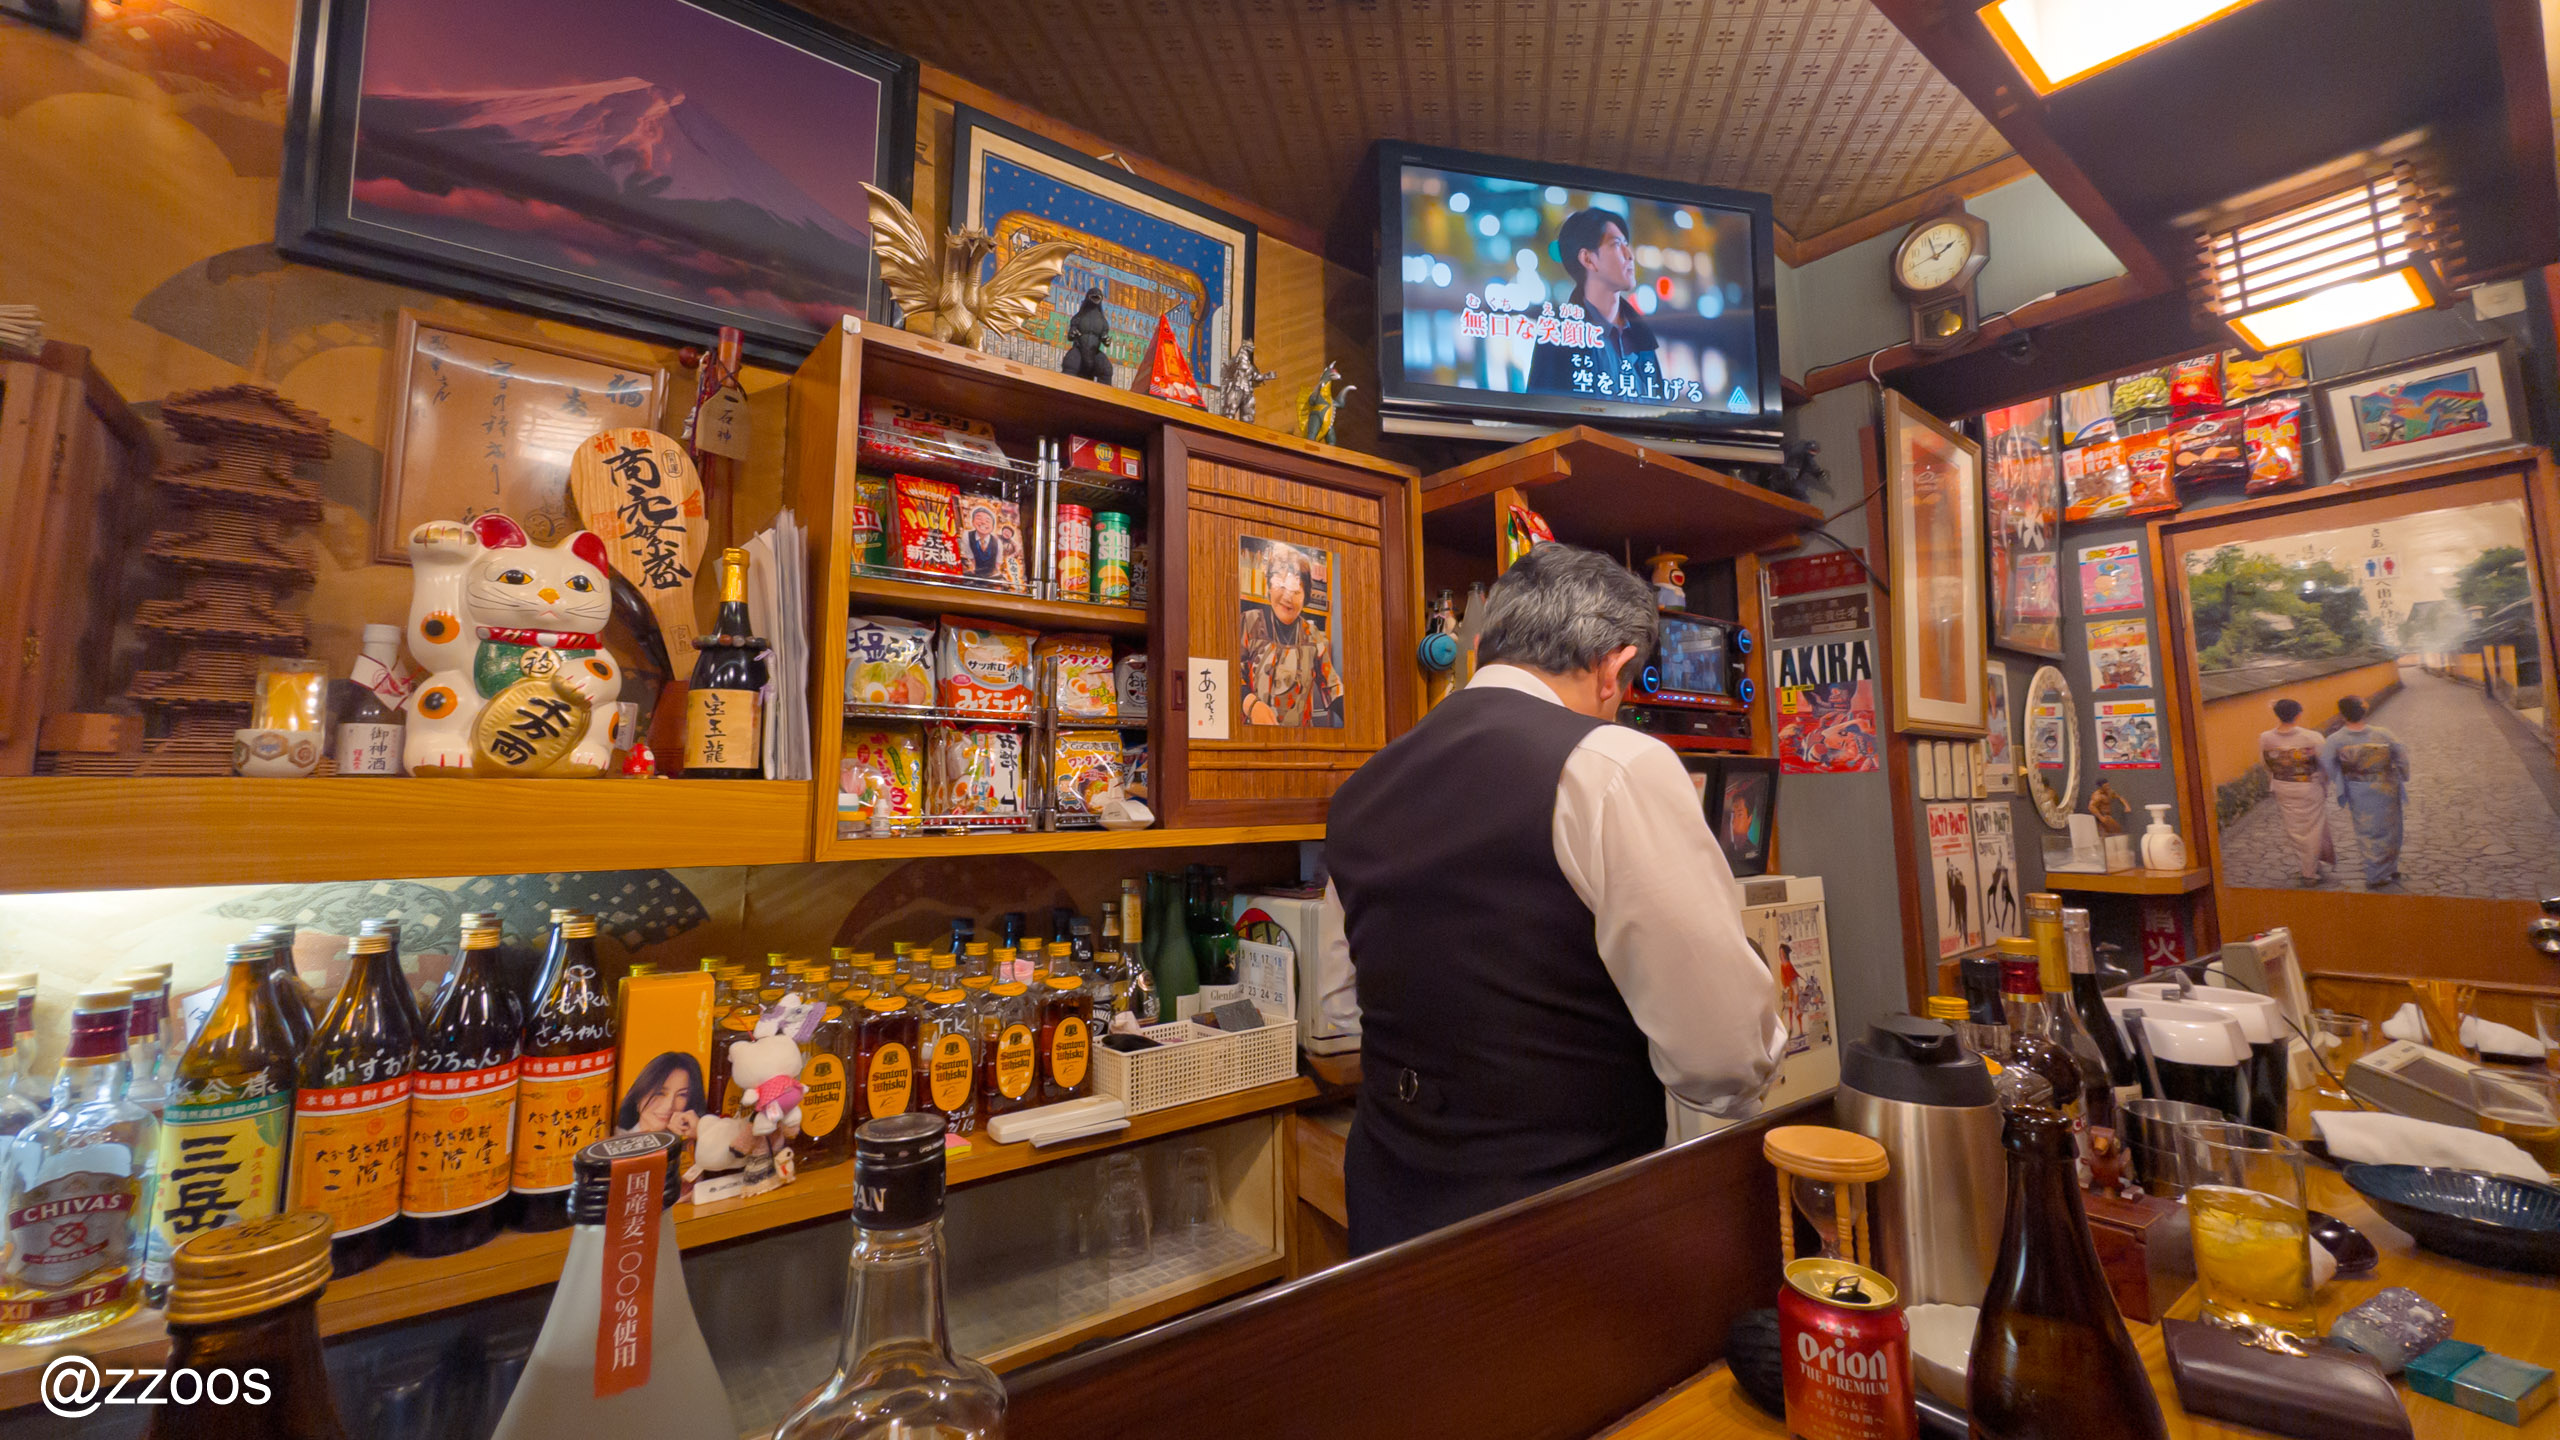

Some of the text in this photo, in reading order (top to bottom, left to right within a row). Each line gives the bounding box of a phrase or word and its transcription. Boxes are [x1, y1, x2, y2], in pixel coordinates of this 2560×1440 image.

[1461, 311, 1605, 349] 無口な笑顔に
[1572, 370, 1704, 403] 空を見上げる
[1779, 640, 1872, 687] AKIRA
[367, 726, 390, 771] 御神酒
[872, 1069, 908, 1081] Suntory
[935, 1059, 969, 1071] Suntory
[936, 1069, 968, 1082] Whisky
[808, 1081, 842, 1093] untory
[872, 1079, 907, 1093] Whisky
[163, 1134, 244, 1234] 三岳
[23, 1194, 123, 1223] CHIVAS
[81, 1287, 108, 1309] 12
[1797, 1331, 1888, 1381] Orion
[1800, 1362, 1890, 1395] THE PREMIUM
